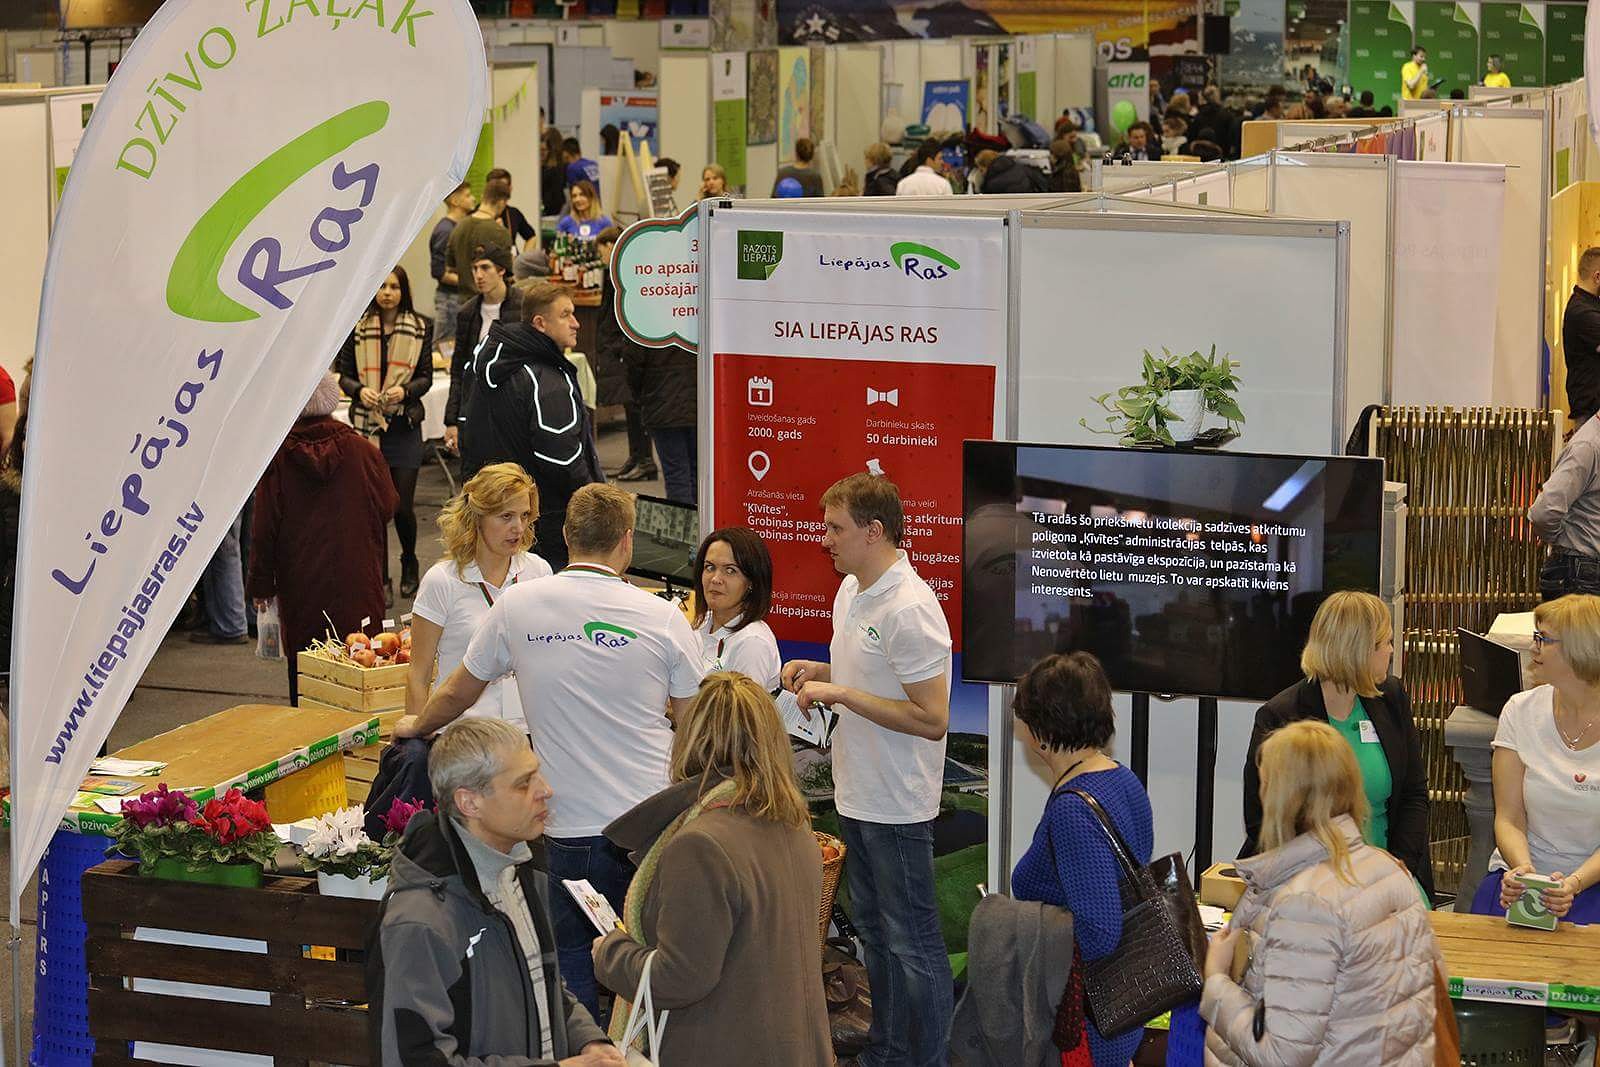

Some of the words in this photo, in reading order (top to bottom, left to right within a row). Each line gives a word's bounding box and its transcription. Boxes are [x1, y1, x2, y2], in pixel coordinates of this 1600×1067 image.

[1107, 73, 1146, 88] arta
[116, 27, 238, 180] DZĪVO
[635, 264, 653, 275] no
[819, 253, 891, 272] Liepājas
[904, 257, 948, 281] Ras
[774, 321, 804, 338] SIA
[810, 321, 894, 345] LIEPĀJAS
[900, 326, 938, 344] RAS
[51, 348, 224, 595] Liepājas
[238, 161, 380, 310] Ras
[797, 416, 817, 426] gads
[866, 418, 909, 431] Darbinieku
[910, 421, 935, 431] skaits
[748, 426, 775, 438] 2000.
[777, 429, 803, 441] gads
[866, 433, 879, 444] 50
[882, 433, 938, 446] darbinieki
[785, 490, 805, 501] vieta
[748, 515, 794, 529] Grobiņas
[1032, 512, 1046, 525] Tā
[1047, 514, 1078, 526] radās
[1080, 515, 1092, 527] šo
[1094, 514, 1154, 531] priekšmetu
[1155, 518, 1202, 534] kolekcija
[1204, 520, 1251, 535] sadzīves
[1252, 523, 1306, 537] atkritumu
[1032, 531, 1077, 544] poligona
[1125, 534, 1206, 552] administrācijas
[1210, 539, 1247, 554] telpās,
[1249, 540, 1268, 553] kas
[912, 551, 960, 565] biogāzes
[1032, 547, 1077, 561] izvietota
[1079, 549, 1092, 562] kā
[1094, 550, 1146, 567] pastāvīga
[1147, 553, 1208, 570] ekspozīcija,
[1210, 559, 1224, 570] un
[1225, 557, 1282, 573] pazīstama
[1283, 560, 1296, 573] kā
[1032, 565, 1098, 580] Nenovērtēto
[1099, 568, 1124, 582] lietu
[1128, 572, 1169, 586] muzejs.
[1170, 572, 1184, 585] To
[1186, 576, 1204, 586] var
[1205, 574, 1249, 590] apskatīt
[1251, 576, 1289, 591] ikviens
[1031, 583, 1094, 598] interesents.
[46, 501, 206, 765] www.liepajasras.lv
[527, 632, 583, 644] Liepājas
[595, 632, 629, 648] Ras
